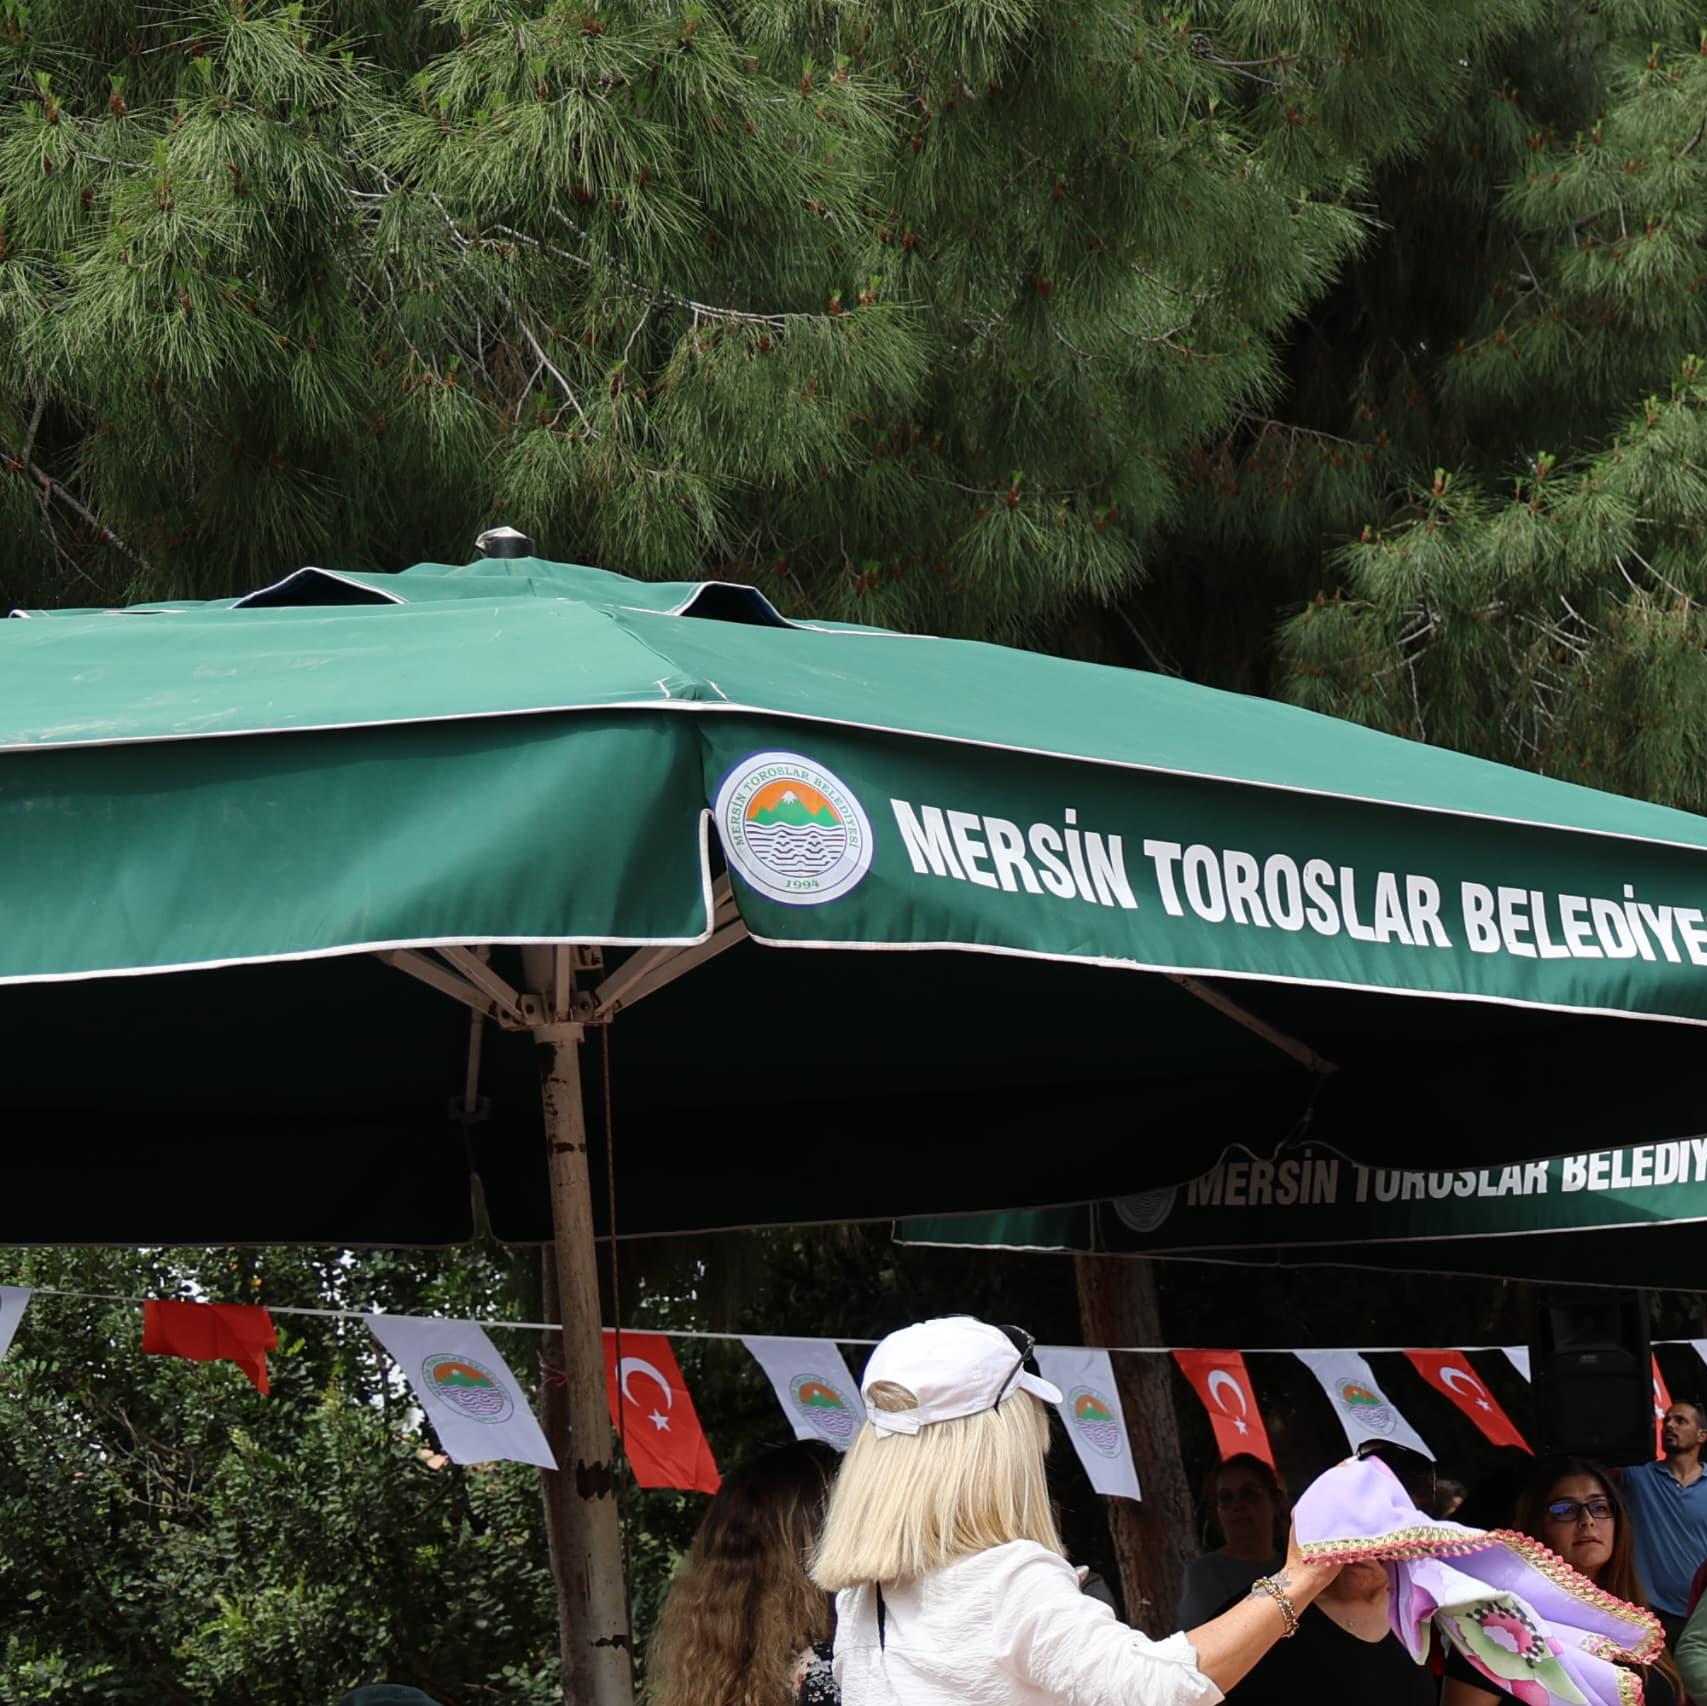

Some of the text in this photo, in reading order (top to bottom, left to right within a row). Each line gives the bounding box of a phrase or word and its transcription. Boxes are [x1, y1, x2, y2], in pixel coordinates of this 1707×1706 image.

[731, 766, 860, 849] MERSİN TOROSLAR BELEDİYESİ
[784, 879, 820, 890] 1994
[890, 798, 1138, 910] MERSİN
[1144, 839, 1453, 948] TOROSLAR
